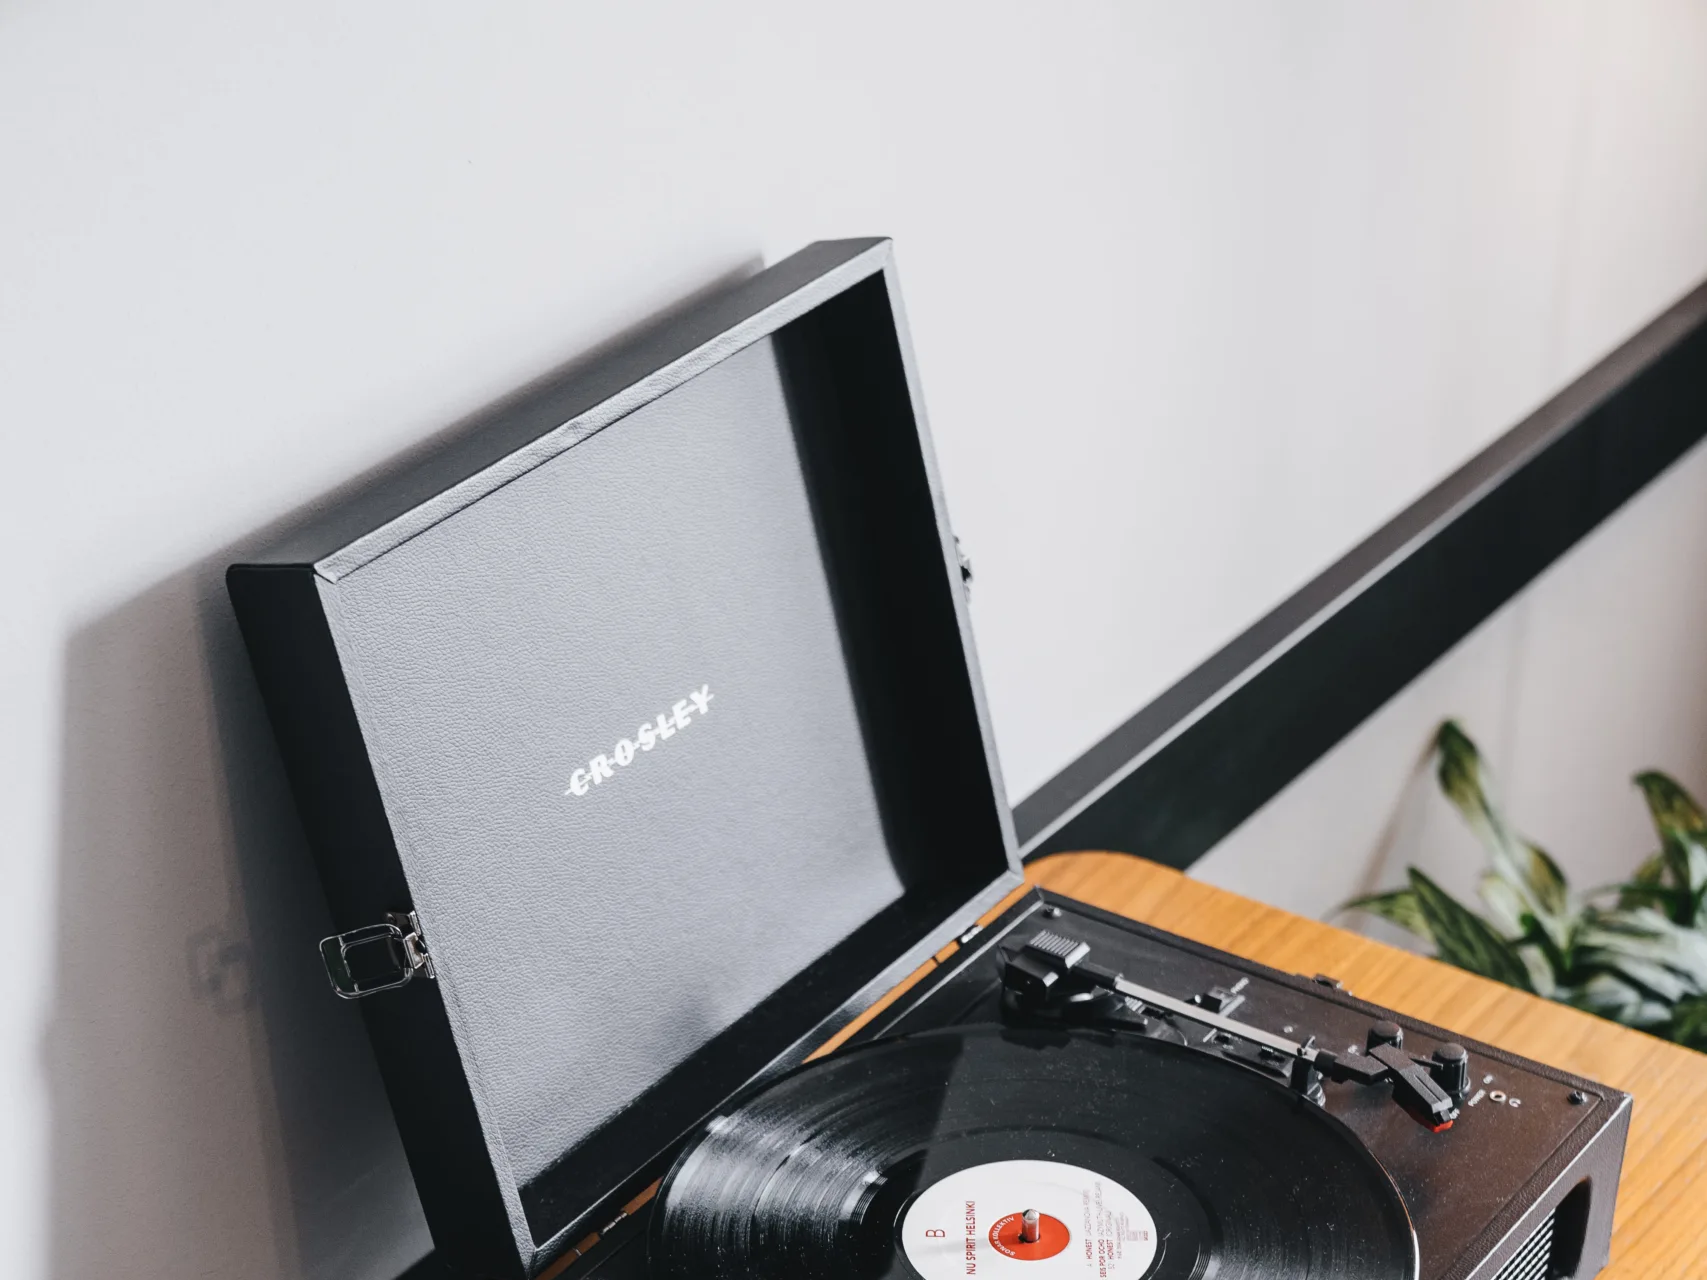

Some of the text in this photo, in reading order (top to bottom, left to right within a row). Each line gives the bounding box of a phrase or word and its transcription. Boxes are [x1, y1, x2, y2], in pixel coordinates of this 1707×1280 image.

[565, 684, 714, 796] CROSLEY
[925, 1228, 946, 1239] B
[965, 1200, 976, 1275] NU SPIRIT HELSINKI
[992, 1216, 1016, 1256] SONAR KOLLEKTIV
